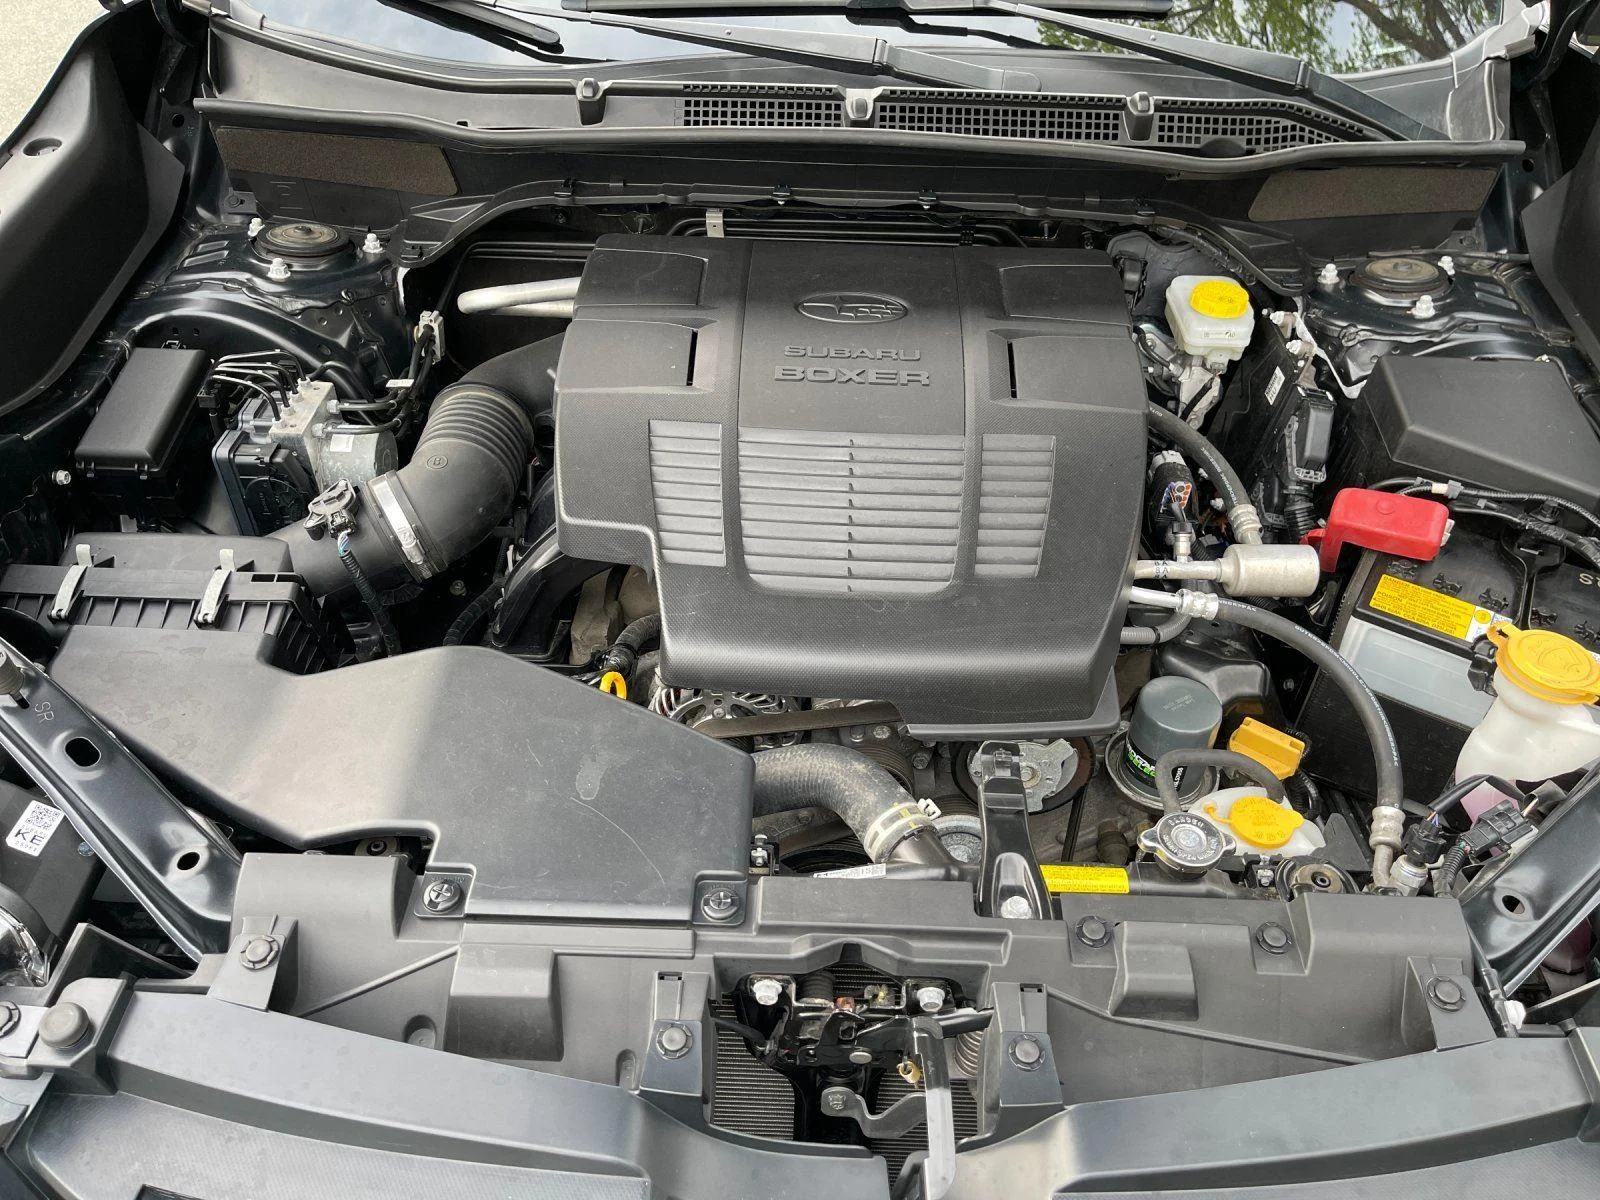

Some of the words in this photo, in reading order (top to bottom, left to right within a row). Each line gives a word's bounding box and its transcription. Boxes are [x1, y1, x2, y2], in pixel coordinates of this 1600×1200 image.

[784, 345, 921, 361] SUBARU
[774, 365, 930, 387] BOXER
[34, 701, 55, 725] SR
[14, 828, 45, 846] KE
